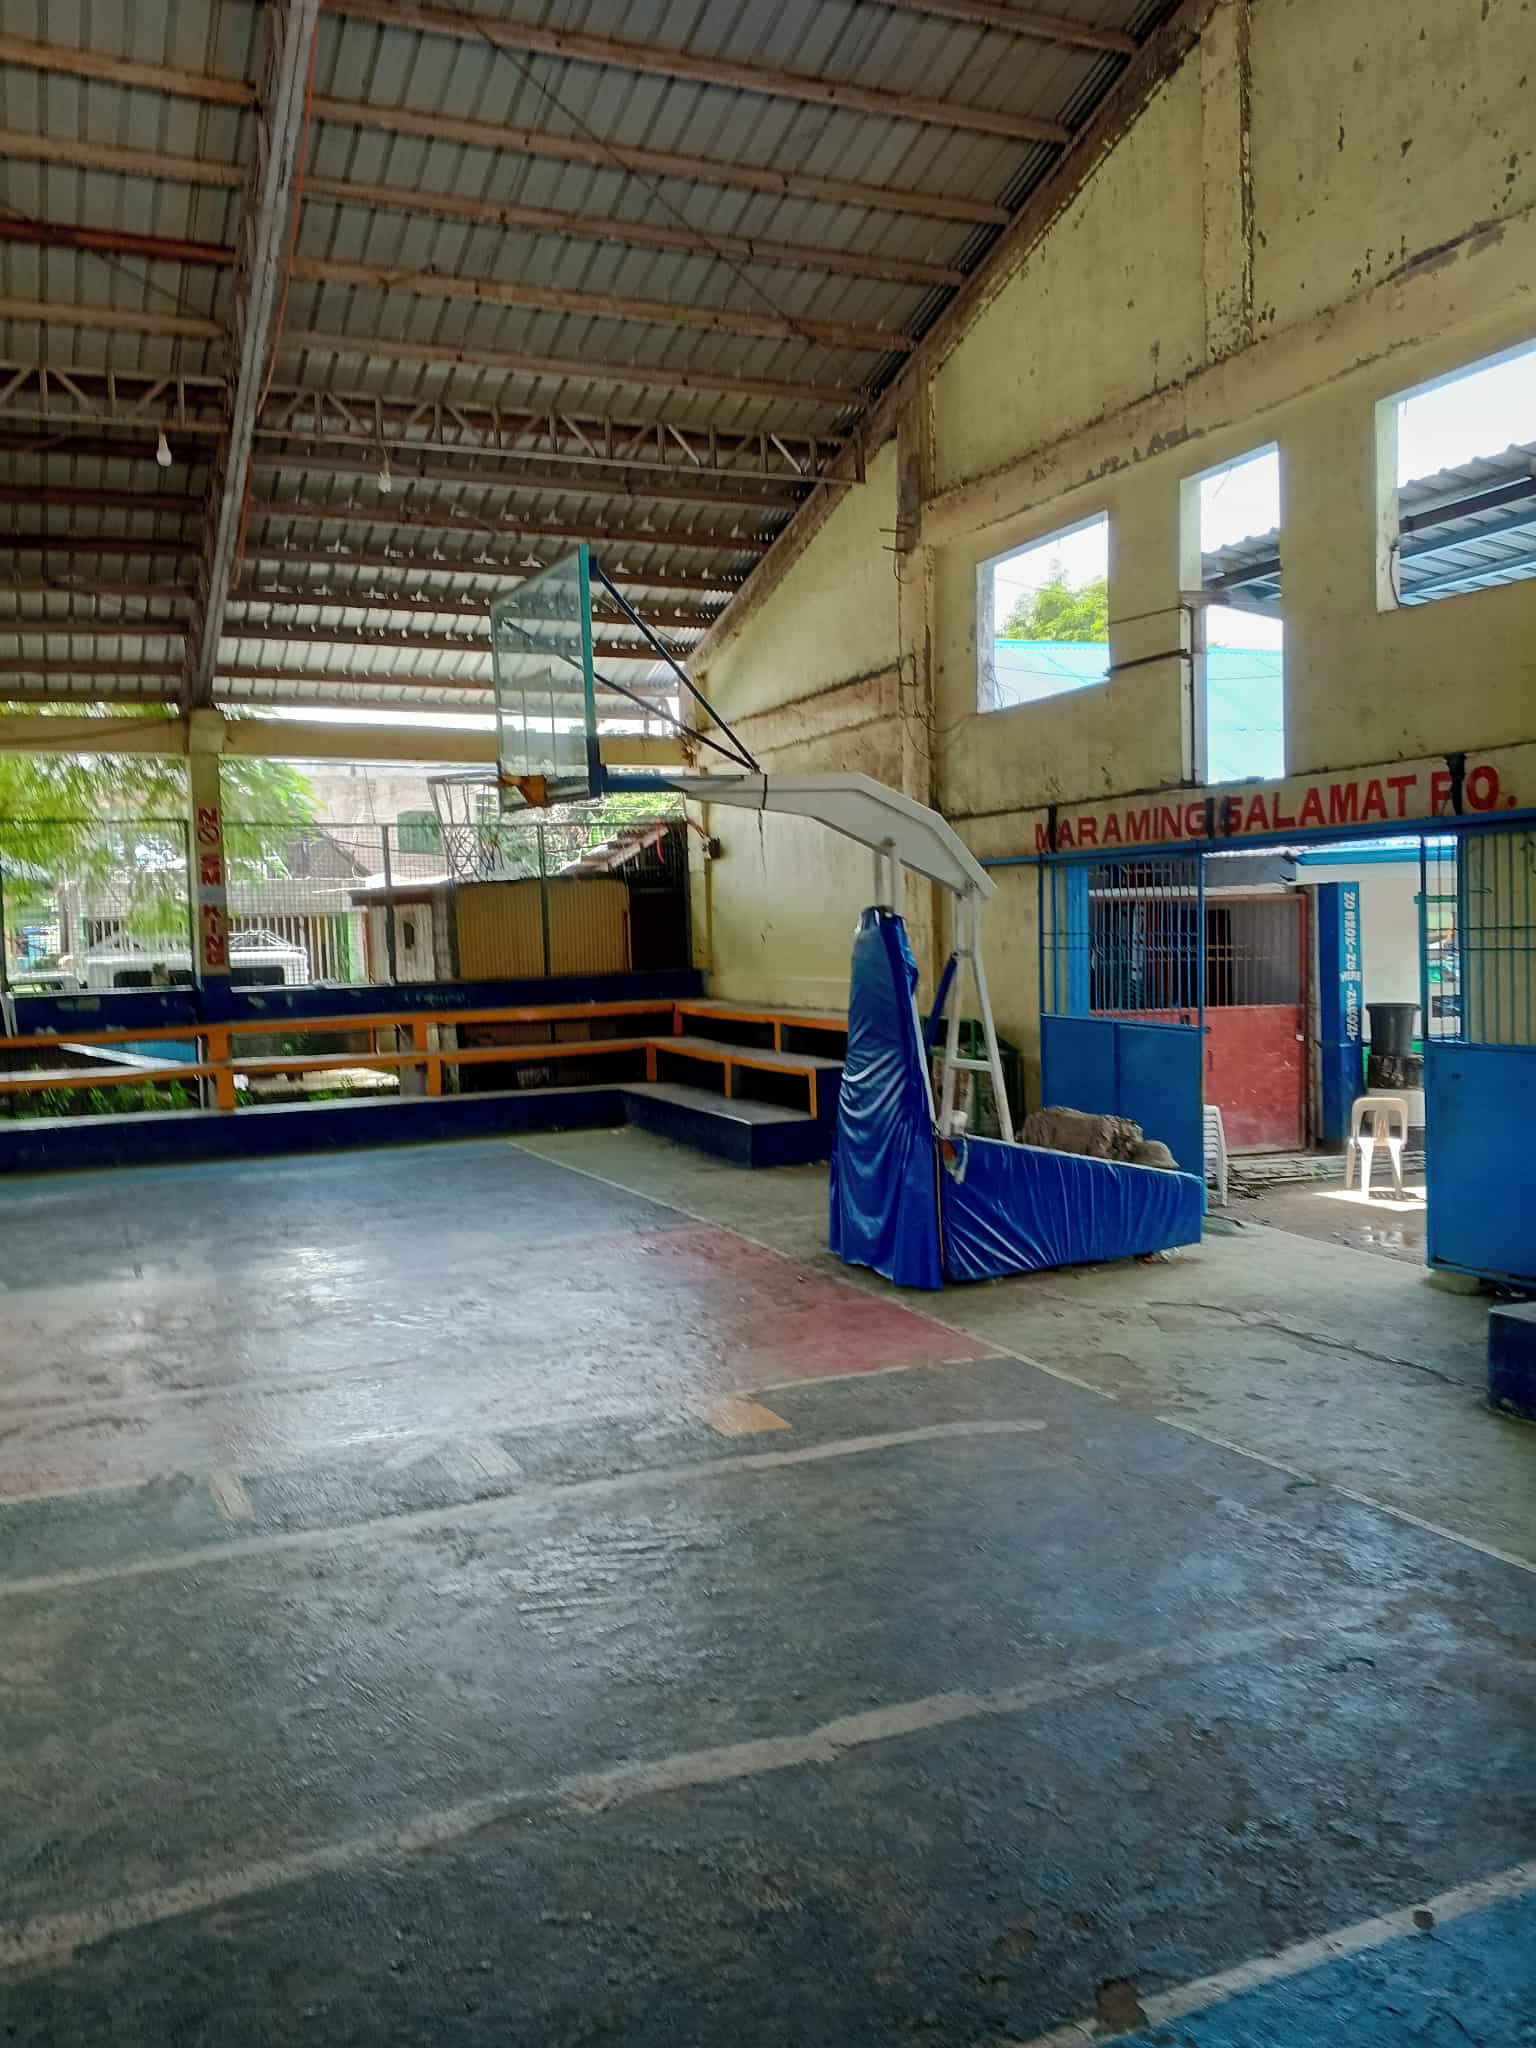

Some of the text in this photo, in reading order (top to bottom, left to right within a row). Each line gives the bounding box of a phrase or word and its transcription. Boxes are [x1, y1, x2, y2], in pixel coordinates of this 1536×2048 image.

[1034, 802, 1207, 851] MARAMING
[1219, 774, 1417, 833] SALAMAT
[200, 855, 225, 965] SMKING
